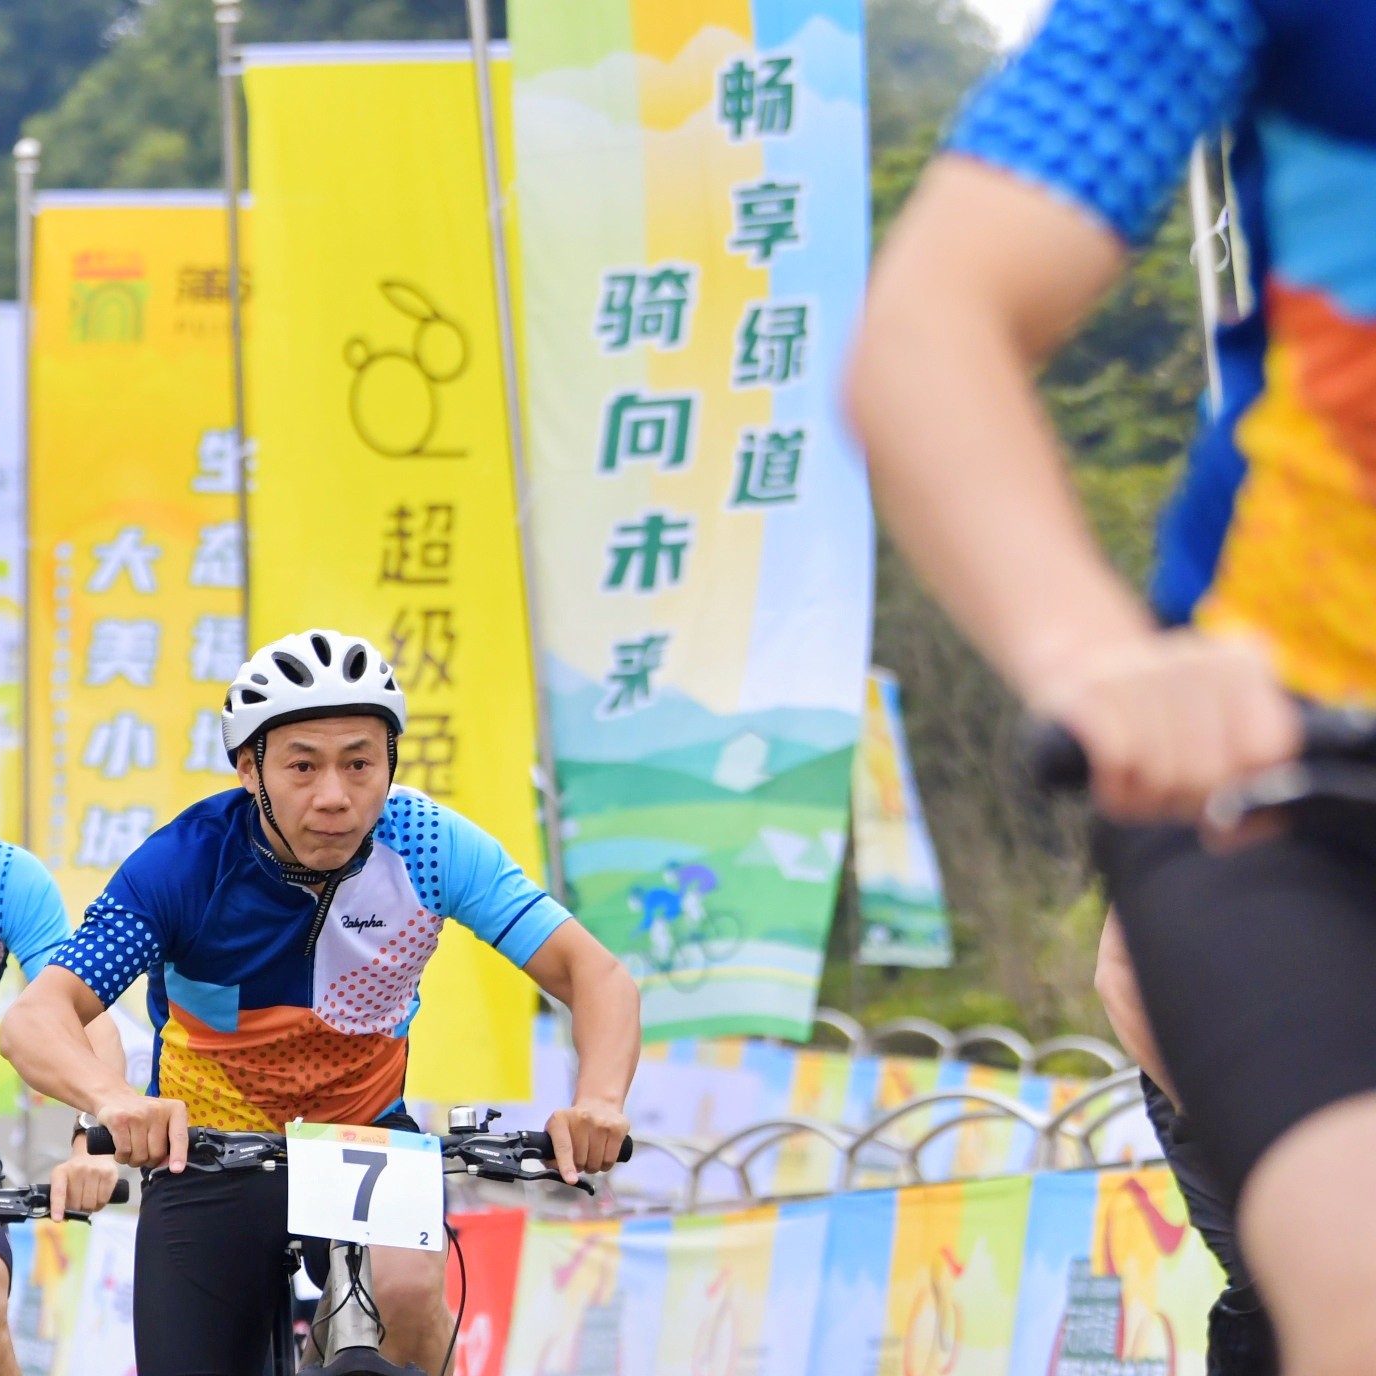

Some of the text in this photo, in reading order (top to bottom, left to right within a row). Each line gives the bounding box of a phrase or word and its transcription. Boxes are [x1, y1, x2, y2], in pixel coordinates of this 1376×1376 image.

[720, 56, 807, 508] 畅享绿道
[597, 268, 693, 713] 骑向未来
[76, 527, 160, 869] 大美小城
[342, 1148, 388, 1223] 7
[419, 1231, 429, 1246] 2
